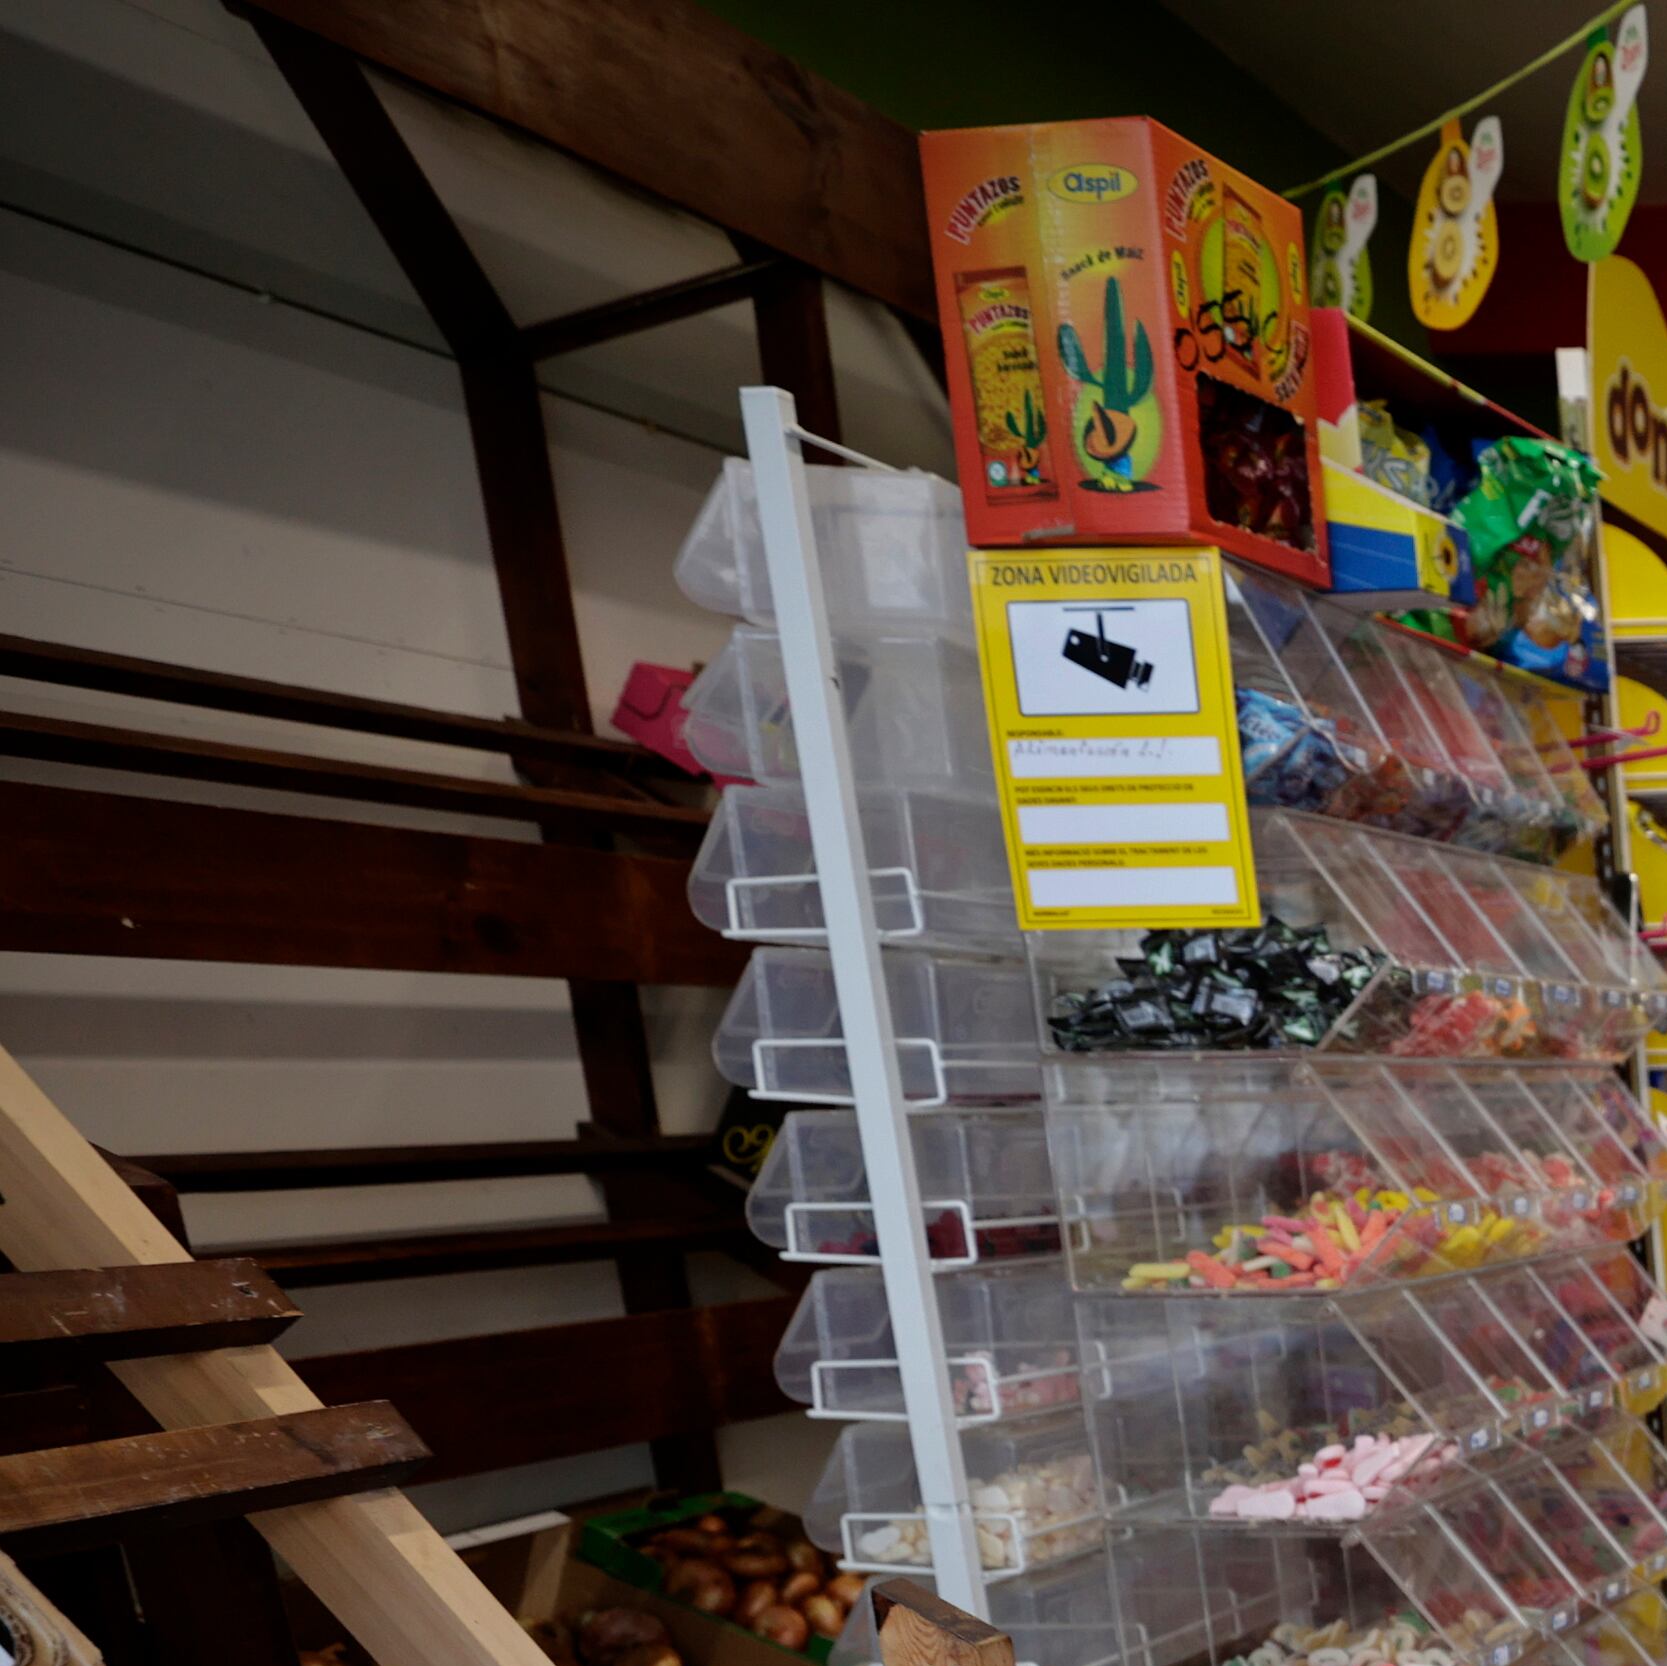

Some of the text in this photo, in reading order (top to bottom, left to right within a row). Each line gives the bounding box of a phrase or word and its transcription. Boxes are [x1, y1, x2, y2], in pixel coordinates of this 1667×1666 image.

[944, 176, 1021, 245] PUNTAZOS
[1165, 159, 1209, 242] PUNTAZOS
[991, 563, 1198, 587] ZONA VIDEOVIGILADA
